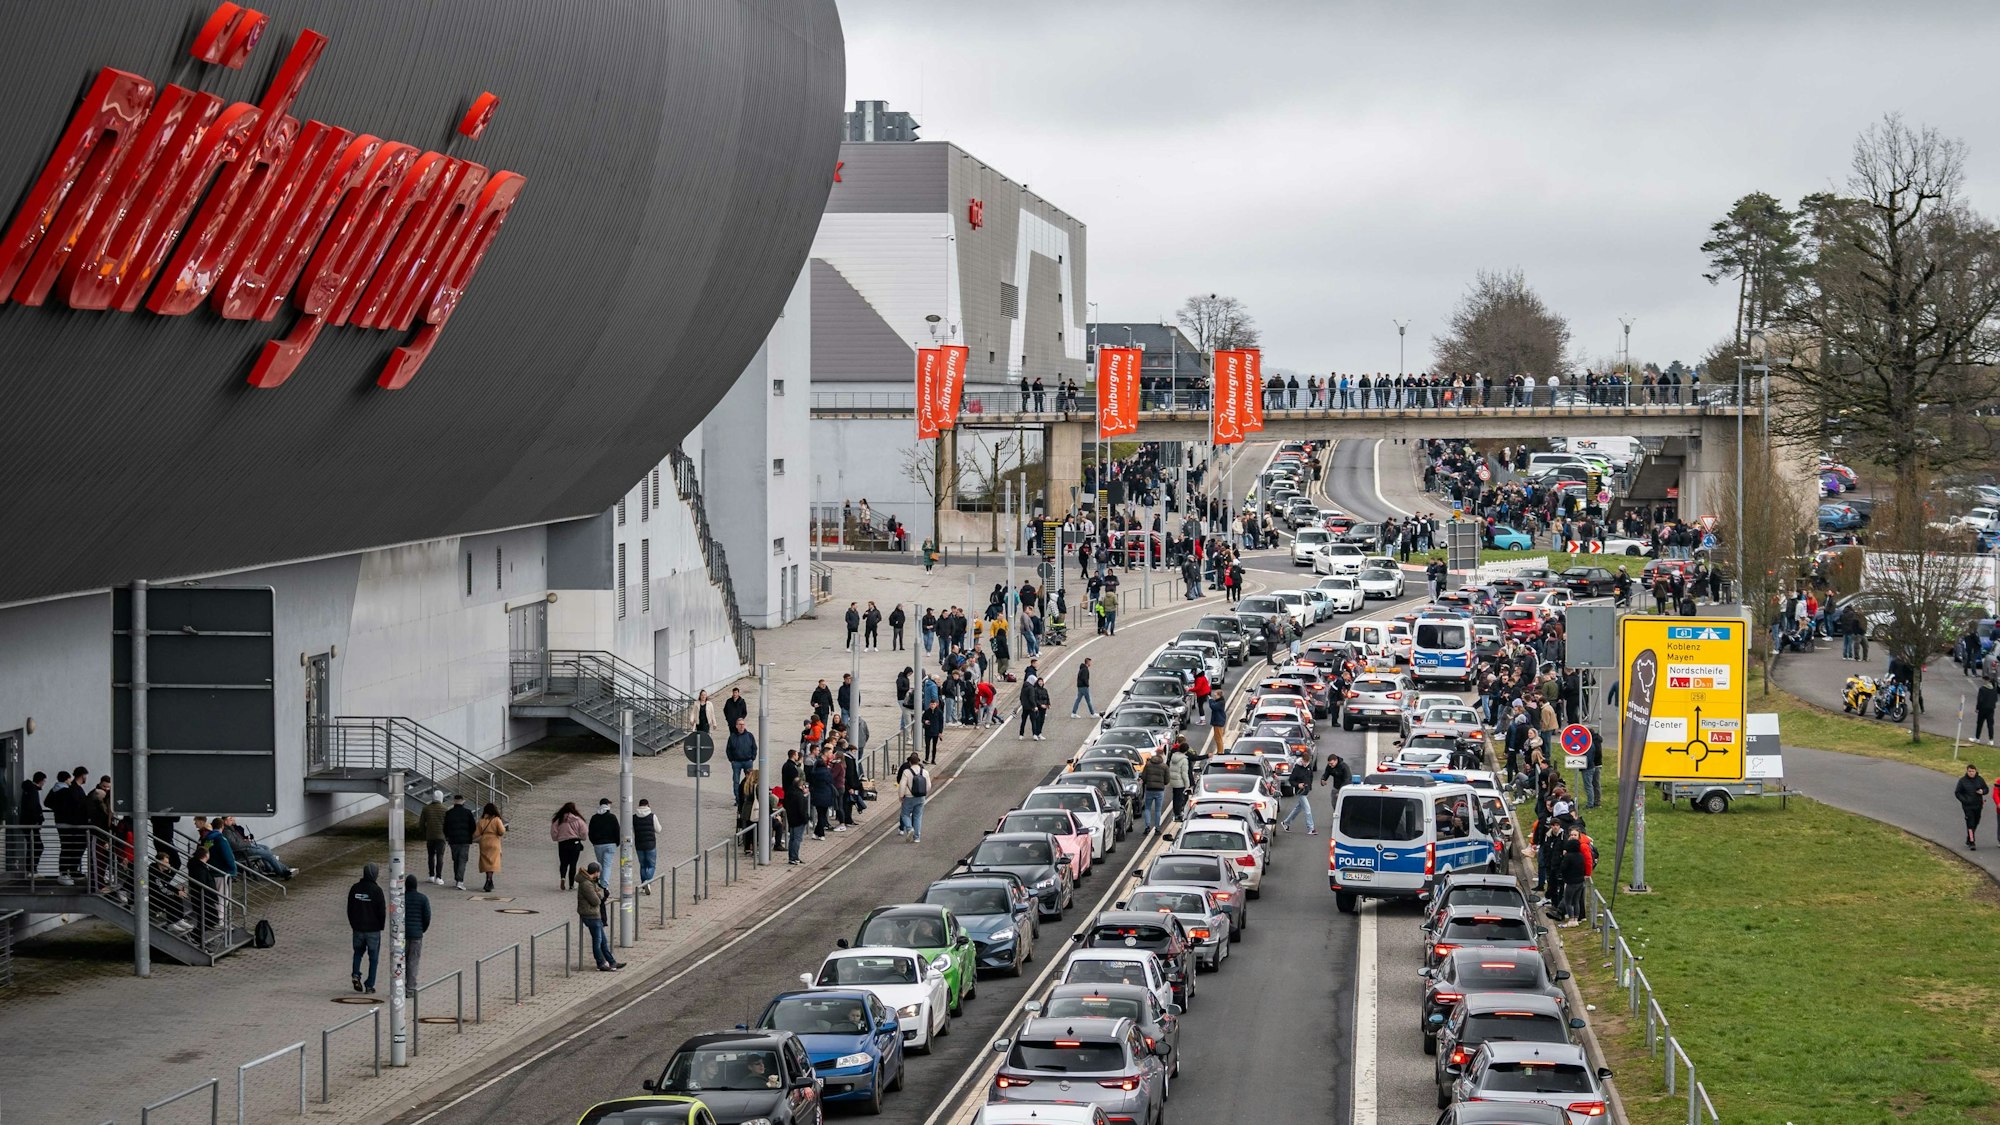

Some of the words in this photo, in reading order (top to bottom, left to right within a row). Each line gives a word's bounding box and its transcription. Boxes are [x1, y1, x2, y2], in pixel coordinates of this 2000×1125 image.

[0, 1, 527, 389] nürburgring
[941, 349, 959, 411] nürburgring
[1108, 354, 1121, 416] nürburgring
[1226, 356, 1239, 424] nürburgring
[1244, 353, 1254, 414] nürburgring
[1667, 642, 1701, 651] Koblenz
[1667, 653, 1695, 662] Mayen
[1669, 666, 1723, 675] Nordschleife
[1701, 719, 1739, 727] Ring-Carré
[1339, 857, 1375, 867] POLIZEI
